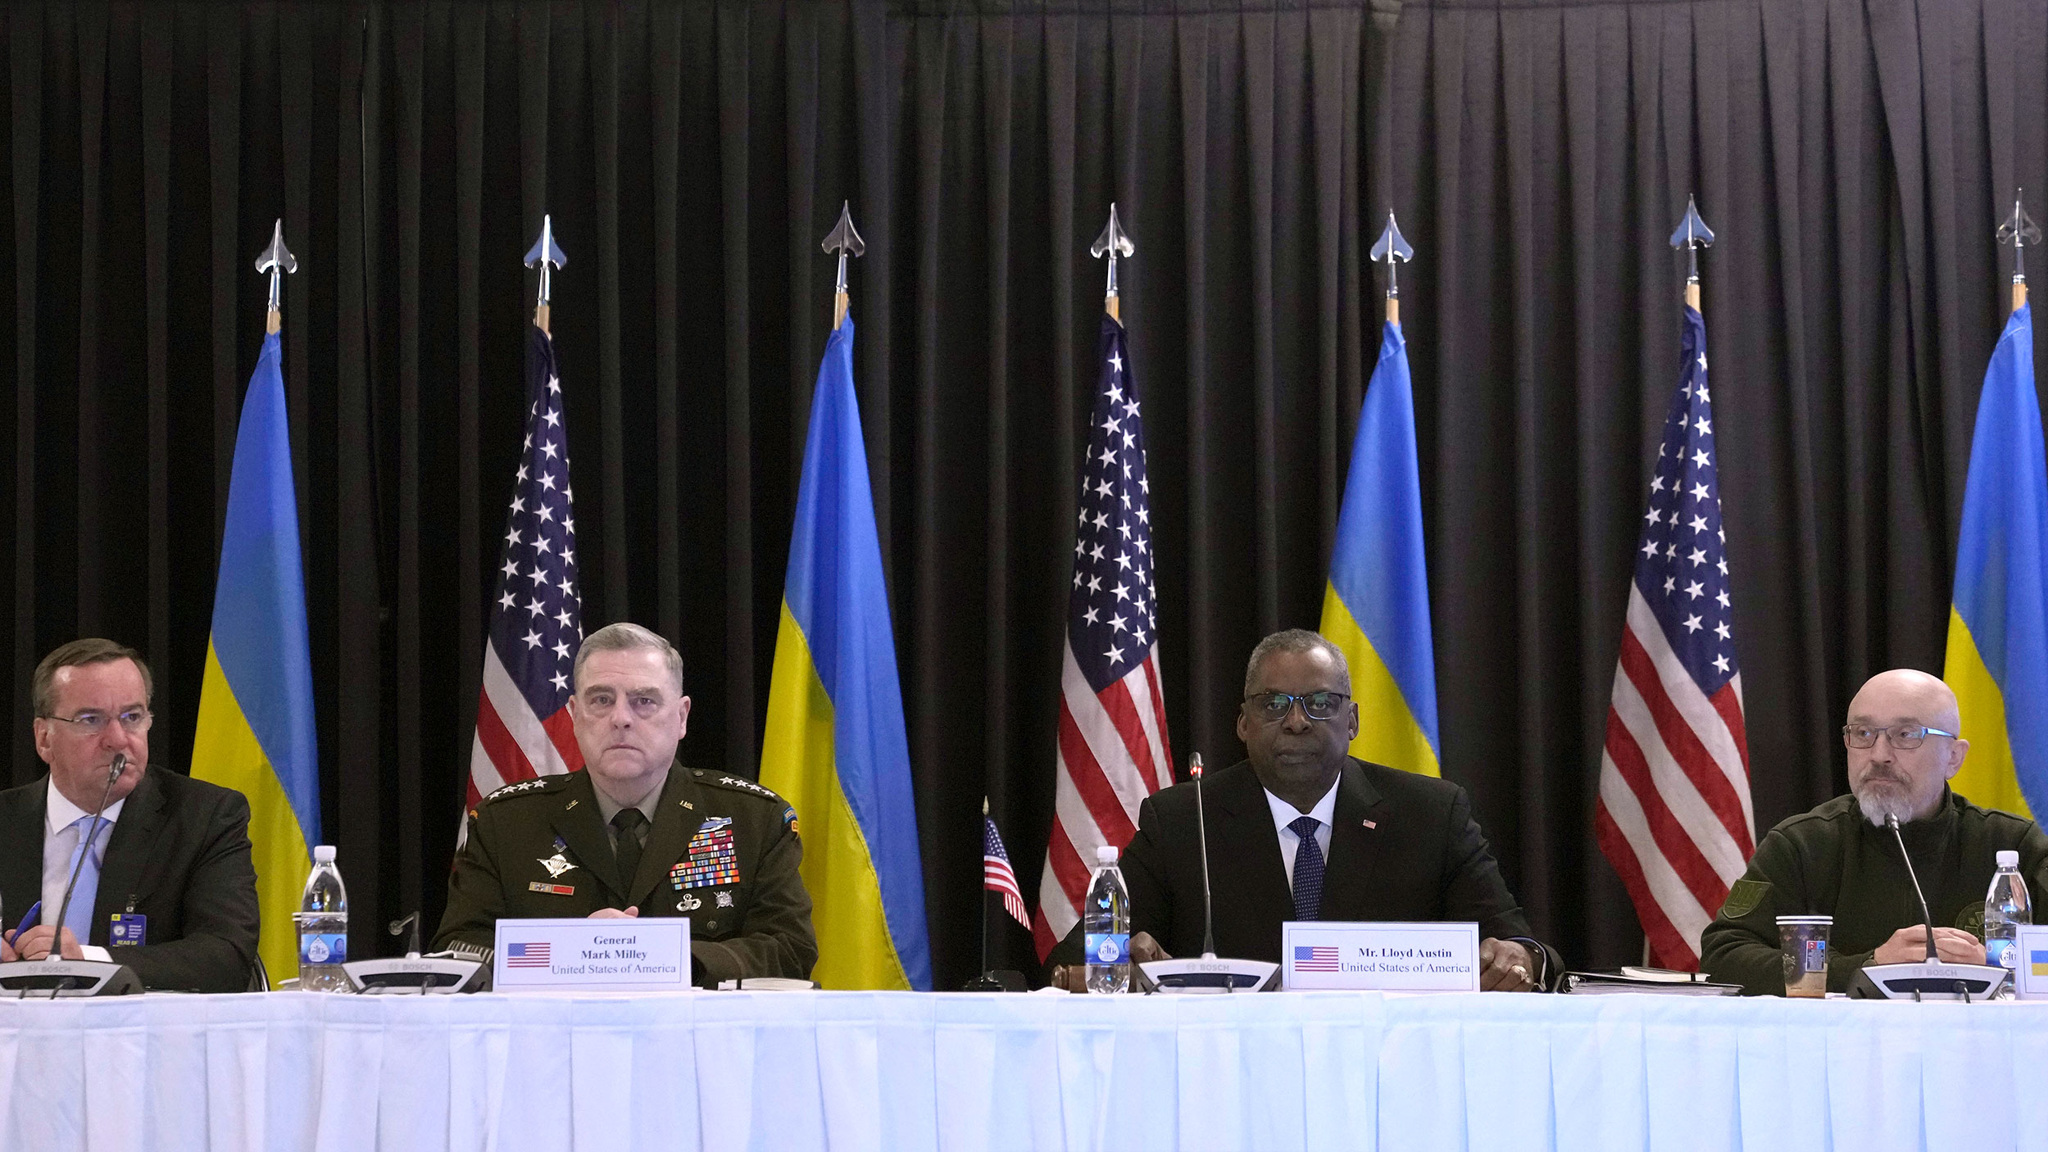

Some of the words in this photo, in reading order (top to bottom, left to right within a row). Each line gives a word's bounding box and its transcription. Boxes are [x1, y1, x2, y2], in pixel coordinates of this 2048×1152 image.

[593, 935, 637, 946] General
[581, 949, 611, 960] Mark
[613, 949, 648, 961] Milley
[1358, 947, 1379, 958] Mr.
[1381, 947, 1414, 961] Lloyd
[1416, 948, 1453, 959] Austin
[402, 963, 433, 972] BOSCH
[551, 964, 586, 975] United
[588, 964, 618, 974] States
[620, 963, 633, 974] of
[633, 963, 677, 974] America
[1200, 963, 1230, 972] BOSCH
[1340, 962, 1376, 973] United
[1378, 962, 1411, 973] States
[1412, 962, 1426, 973] of
[1426, 962, 1471, 974] America
[1926, 968, 1958, 977] BOSCH
